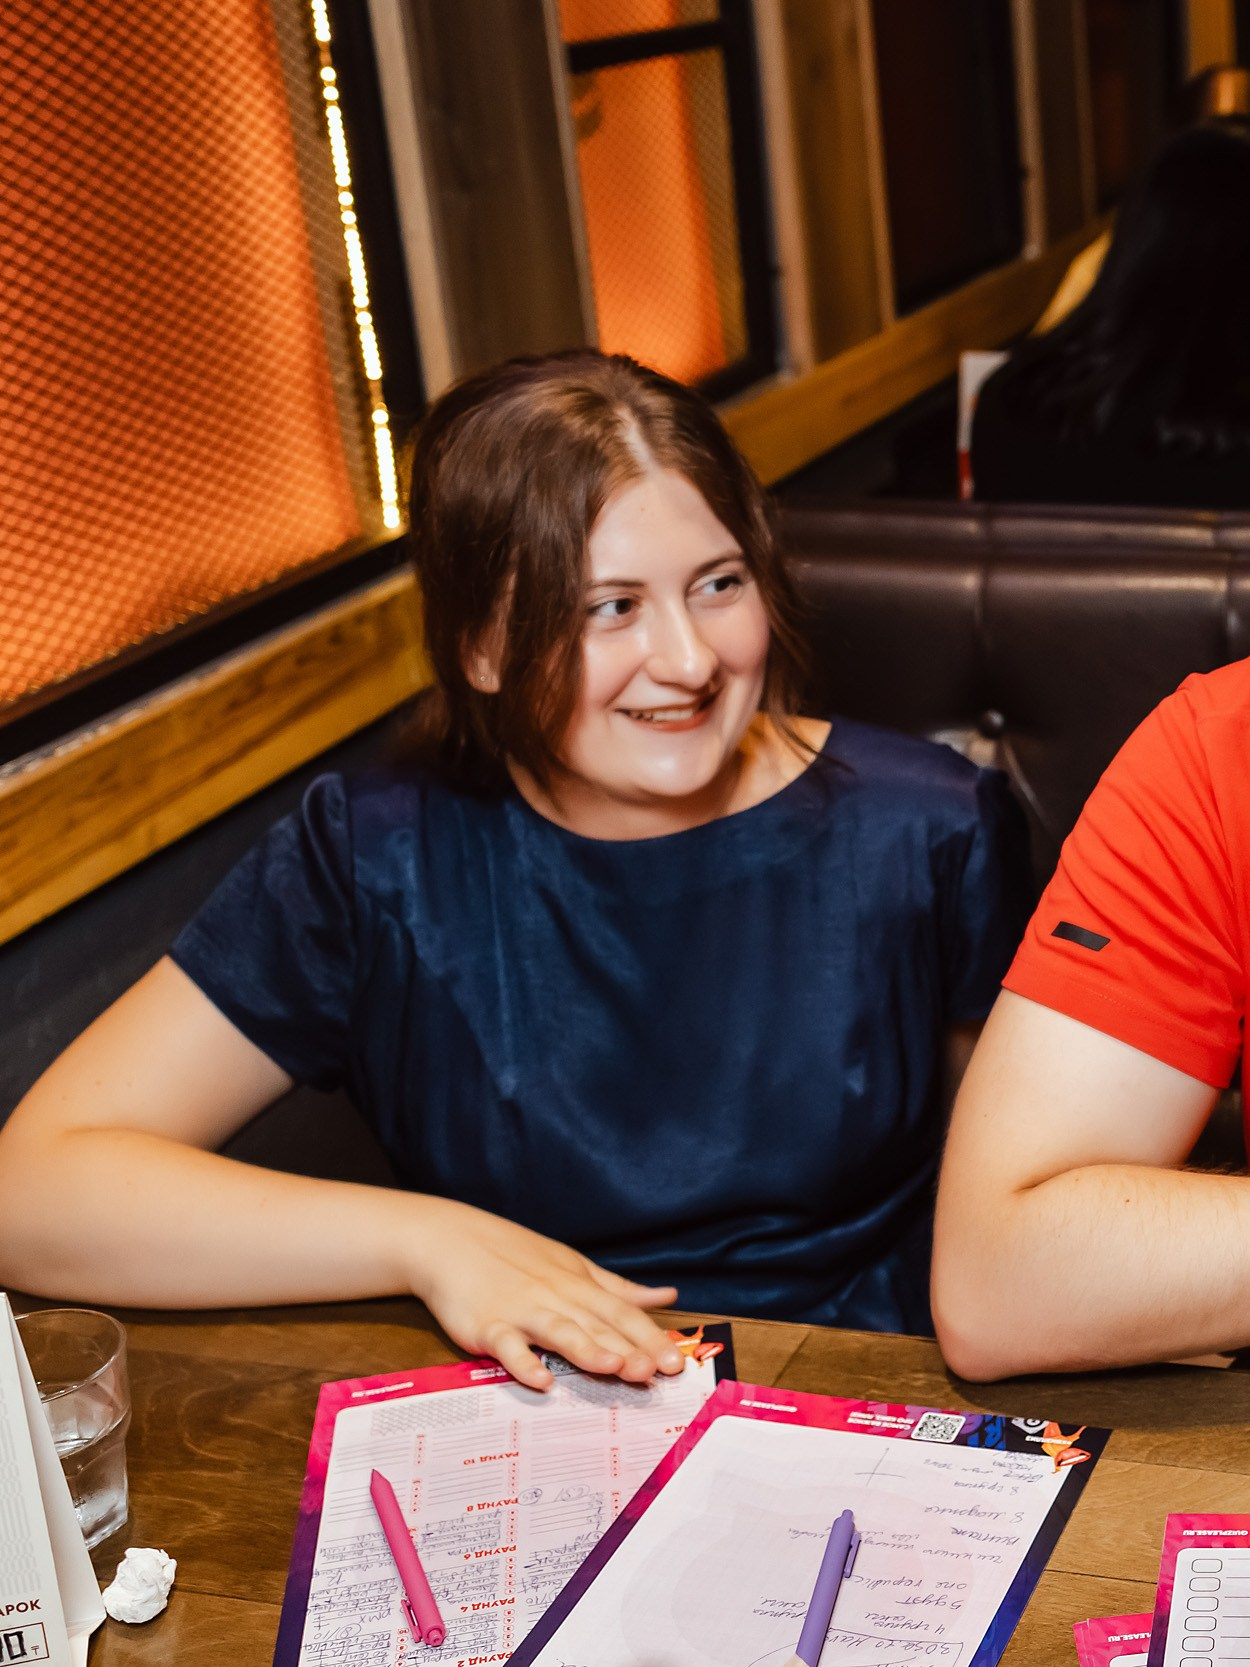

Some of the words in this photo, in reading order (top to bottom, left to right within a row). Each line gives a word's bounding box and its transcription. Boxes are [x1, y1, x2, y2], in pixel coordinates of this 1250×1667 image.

[477, 1498, 518, 1510] РАУНД
[473, 1545, 517, 1558] РАУНД
[472, 1597, 515, 1611] РАУНД
[466, 1651, 513, 1666] РАУНД
